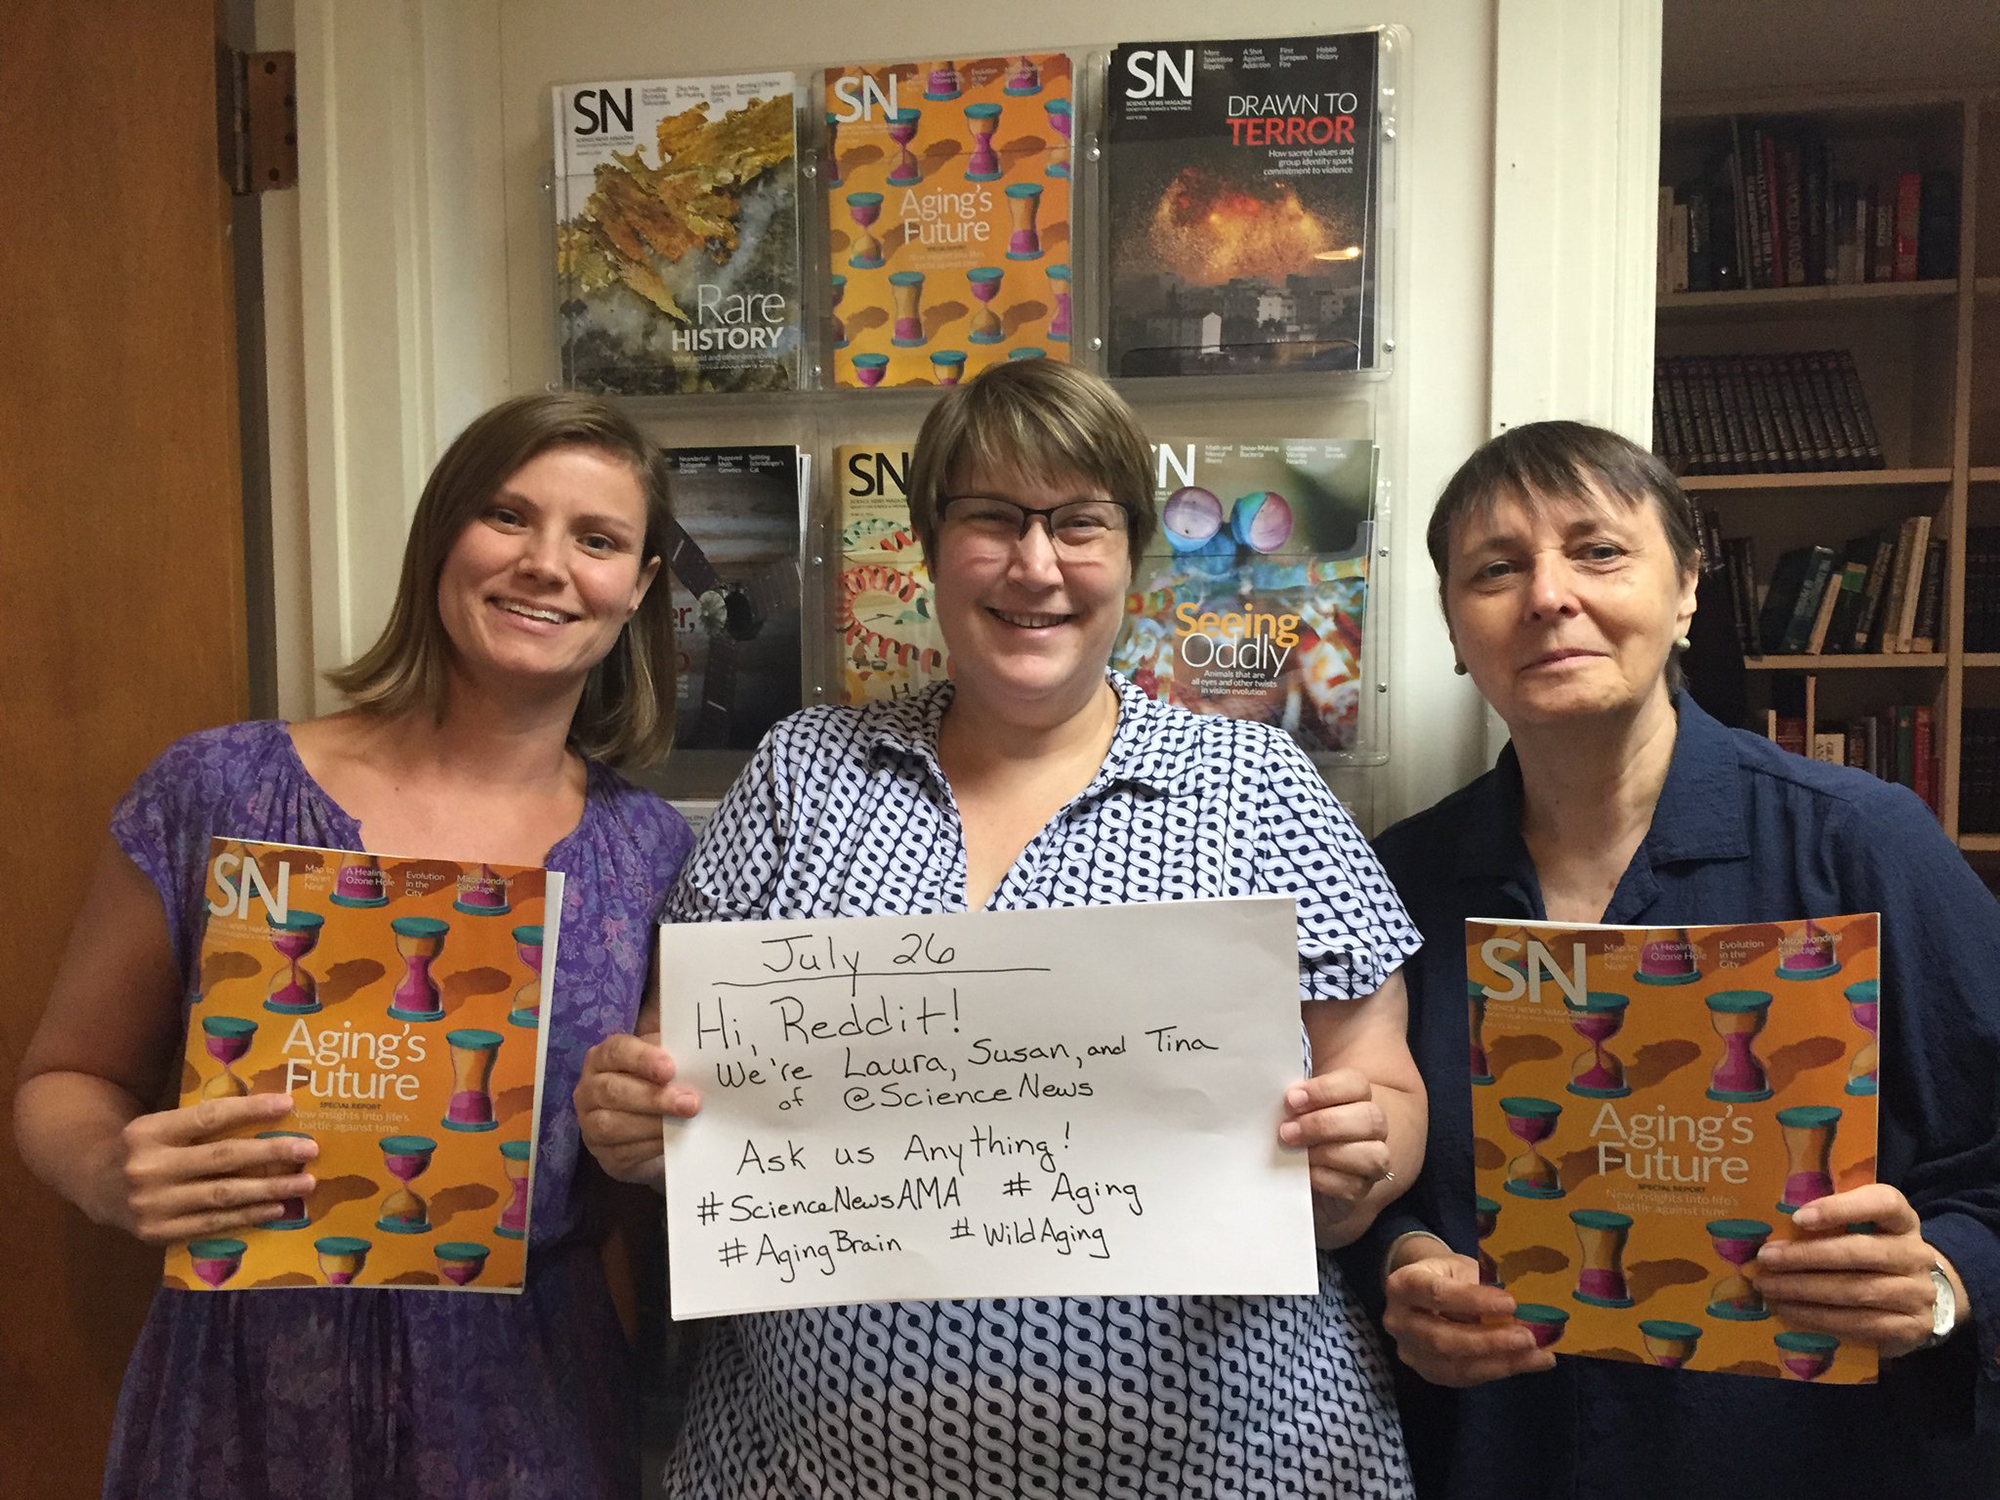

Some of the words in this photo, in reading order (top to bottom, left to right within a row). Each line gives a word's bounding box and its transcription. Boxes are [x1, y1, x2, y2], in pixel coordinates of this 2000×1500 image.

[1316, 53, 1339, 61] History
[1125, 49, 1193, 99] SN
[834, 73, 899, 124] SN
[1228, 94, 1319, 116] DRAWN
[1324, 92, 1358, 115] TO
[573, 87, 634, 136] SN
[1226, 115, 1356, 146] TERROR
[1268, 150, 1287, 158] How
[1287, 148, 1313, 157] sacred
[1314, 147, 1338, 156] values
[1339, 147, 1354, 156] and
[1263, 167, 1311, 176] commitment
[1321, 165, 1353, 175] violence
[1278, 159, 1301, 168] group
[1301, 157, 1331, 167] identity
[1332, 156, 1354, 166] spark
[900, 184, 993, 222] Aging's
[904, 218, 990, 245] Future
[697, 283, 786, 325] Rare
[671, 326, 784, 352] HISTORY
[848, 451, 909, 497] SN
[1150, 443, 1196, 489] N
[1175, 601, 1301, 648] Seeing
[1181, 632, 1293, 678] Oddly
[1191, 678, 1200, 686] all
[1200, 679, 1218, 687] eyes
[1218, 678, 1233, 686] and
[1233, 679, 1254, 687] other
[1254, 680, 1278, 688] twists
[1203, 670, 1234, 678] Animals
[1235, 670, 1251, 679] that
[1209, 687, 1231, 695] vision
[1231, 687, 1267, 696] evolution
[305, 864, 325, 874] Map
[325, 865, 335, 874] to
[346, 867, 354, 875] A
[405, 870, 446, 882] Evolution
[207, 852, 290, 924] SN
[345, 875, 374, 886] Ozone
[375, 877, 396, 887] Hole
[405, 880, 414, 888] in
[415, 880, 430, 889] the
[456, 874, 515, 887] Mitochondrial
[456, 882, 495, 894] Sabotage
[405, 889, 423, 898] City
[1603, 943, 1625, 953] Map
[1627, 943, 1639, 952] to
[1651, 943, 1659, 951] A
[1719, 939, 1765, 950] Evolution
[1650, 952, 1683, 961] Ozone
[1719, 950, 1728, 959] in
[1729, 949, 1747, 959] the
[761, 934, 858, 996] July
[894, 932, 956, 967] 26
[1479, 937, 1588, 1006] SN
[1719, 960, 1740, 969] City
[697, 999, 758, 1058] Hi,
[769, 988, 962, 1042] Reddit!
[281, 1018, 427, 1070] Aging's
[717, 1058, 812, 1088] We're
[843, 1047, 956, 1080] Laura,
[1087, 1036, 1127, 1057] and
[1145, 1025, 1220, 1053] Tina
[286, 1057, 420, 1101] Future
[319, 1101, 348, 1109] SPECIAL
[777, 1088, 804, 1111] of
[318, 1110, 360, 1122] insights
[362, 1111, 383, 1122] into
[385, 1112, 411, 1123] life's
[299, 1121, 331, 1131] battle
[333, 1122, 373, 1134] against
[375, 1123, 400, 1133] time
[1589, 1101, 1754, 1153] Aging's
[736, 1138, 810, 1177] Ask
[835, 1144, 875, 1166] us
[903, 1122, 1072, 1178] Anything!
[1597, 1140, 1750, 1184] Future
[1606, 1188, 1635, 1200] New
[1638, 1190, 1685, 1204] insights
[1686, 1193, 1710, 1204] into
[1712, 1194, 1740, 1206] life's
[1637, 1183, 1671, 1192] SPECIAL
[1672, 1185, 1706, 1194] REPORT
[697, 1176, 962, 1226] #ScienceNewsAMA
[1616, 1201, 1652, 1212] battle
[1655, 1204, 1699, 1217] against
[1701, 1205, 1728, 1216] time
[719, 1231, 902, 1285] #AgingBrain
[950, 1217, 1110, 1259] #WildAging
